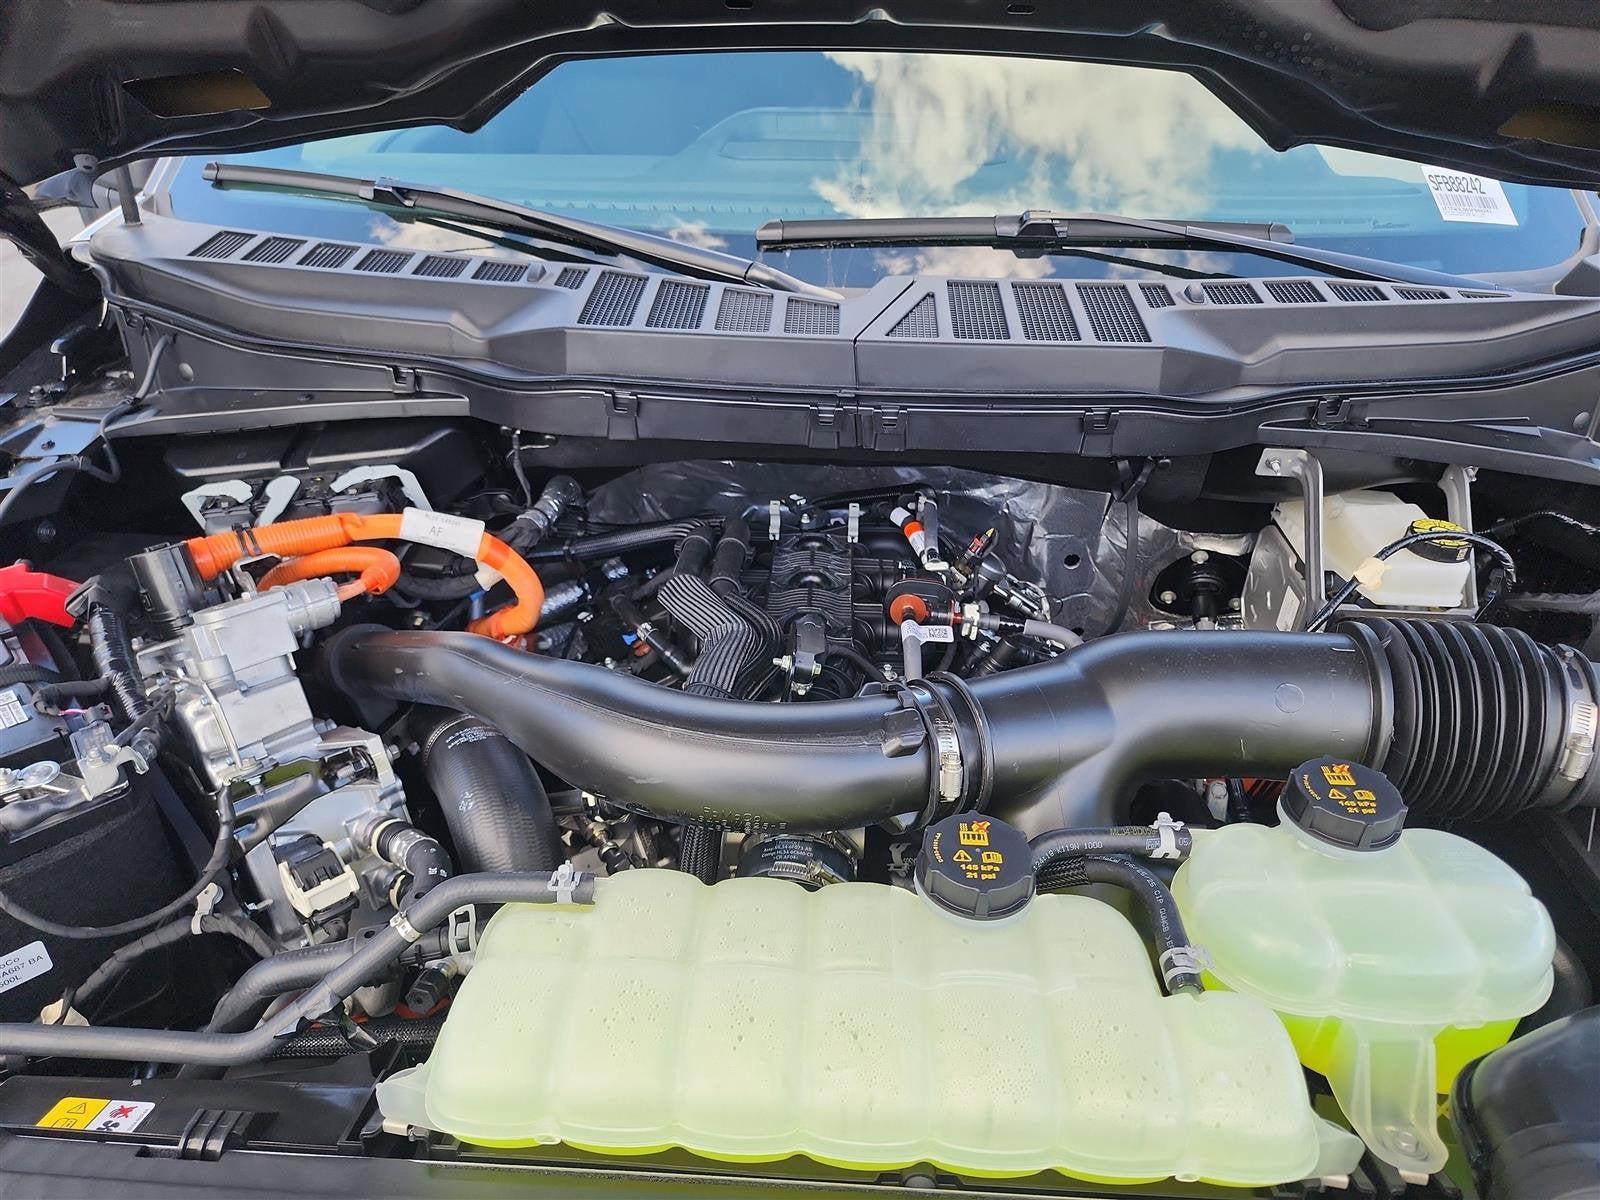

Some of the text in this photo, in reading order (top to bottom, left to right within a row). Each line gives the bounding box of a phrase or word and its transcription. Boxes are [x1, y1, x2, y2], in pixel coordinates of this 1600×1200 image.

[1428, 174, 1486, 195] SFB88242
[960, 863, 1001, 872] 145 kPa
[981, 872, 997, 880] psi
[0, 955, 44, 978] A687 BA
